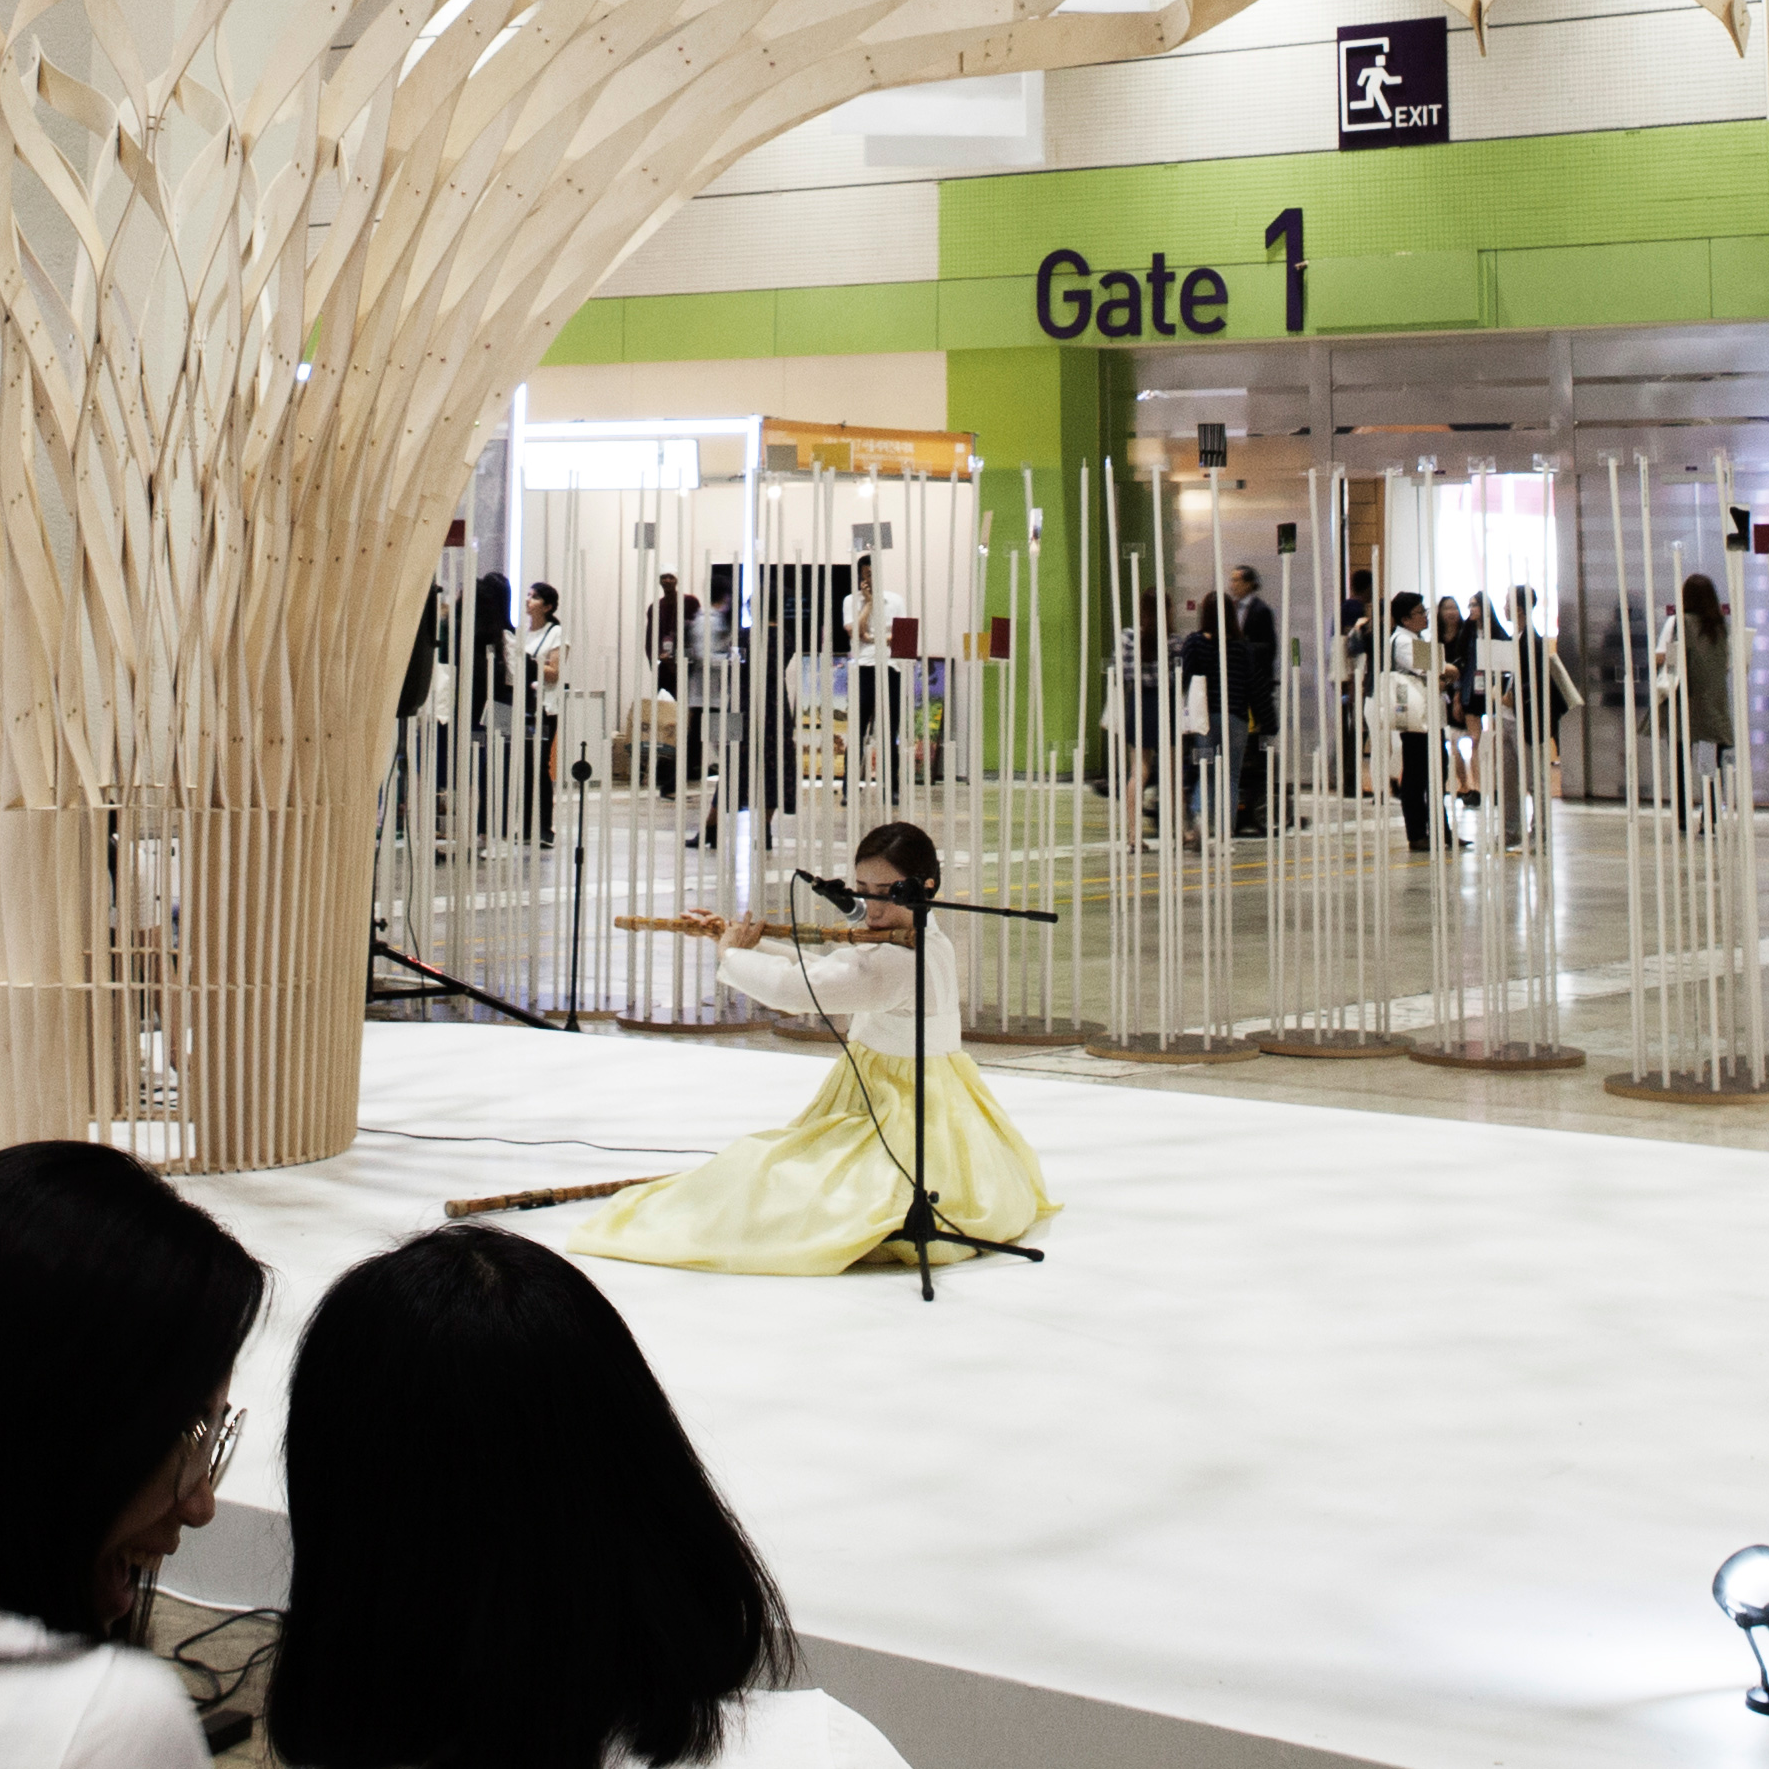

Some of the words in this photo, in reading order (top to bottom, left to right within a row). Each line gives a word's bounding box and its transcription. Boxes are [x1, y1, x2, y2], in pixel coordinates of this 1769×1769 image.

[1394, 104, 1442, 128] EXIT
[1036, 248, 1228, 340] Gate
[1264, 207, 1305, 332] 1
